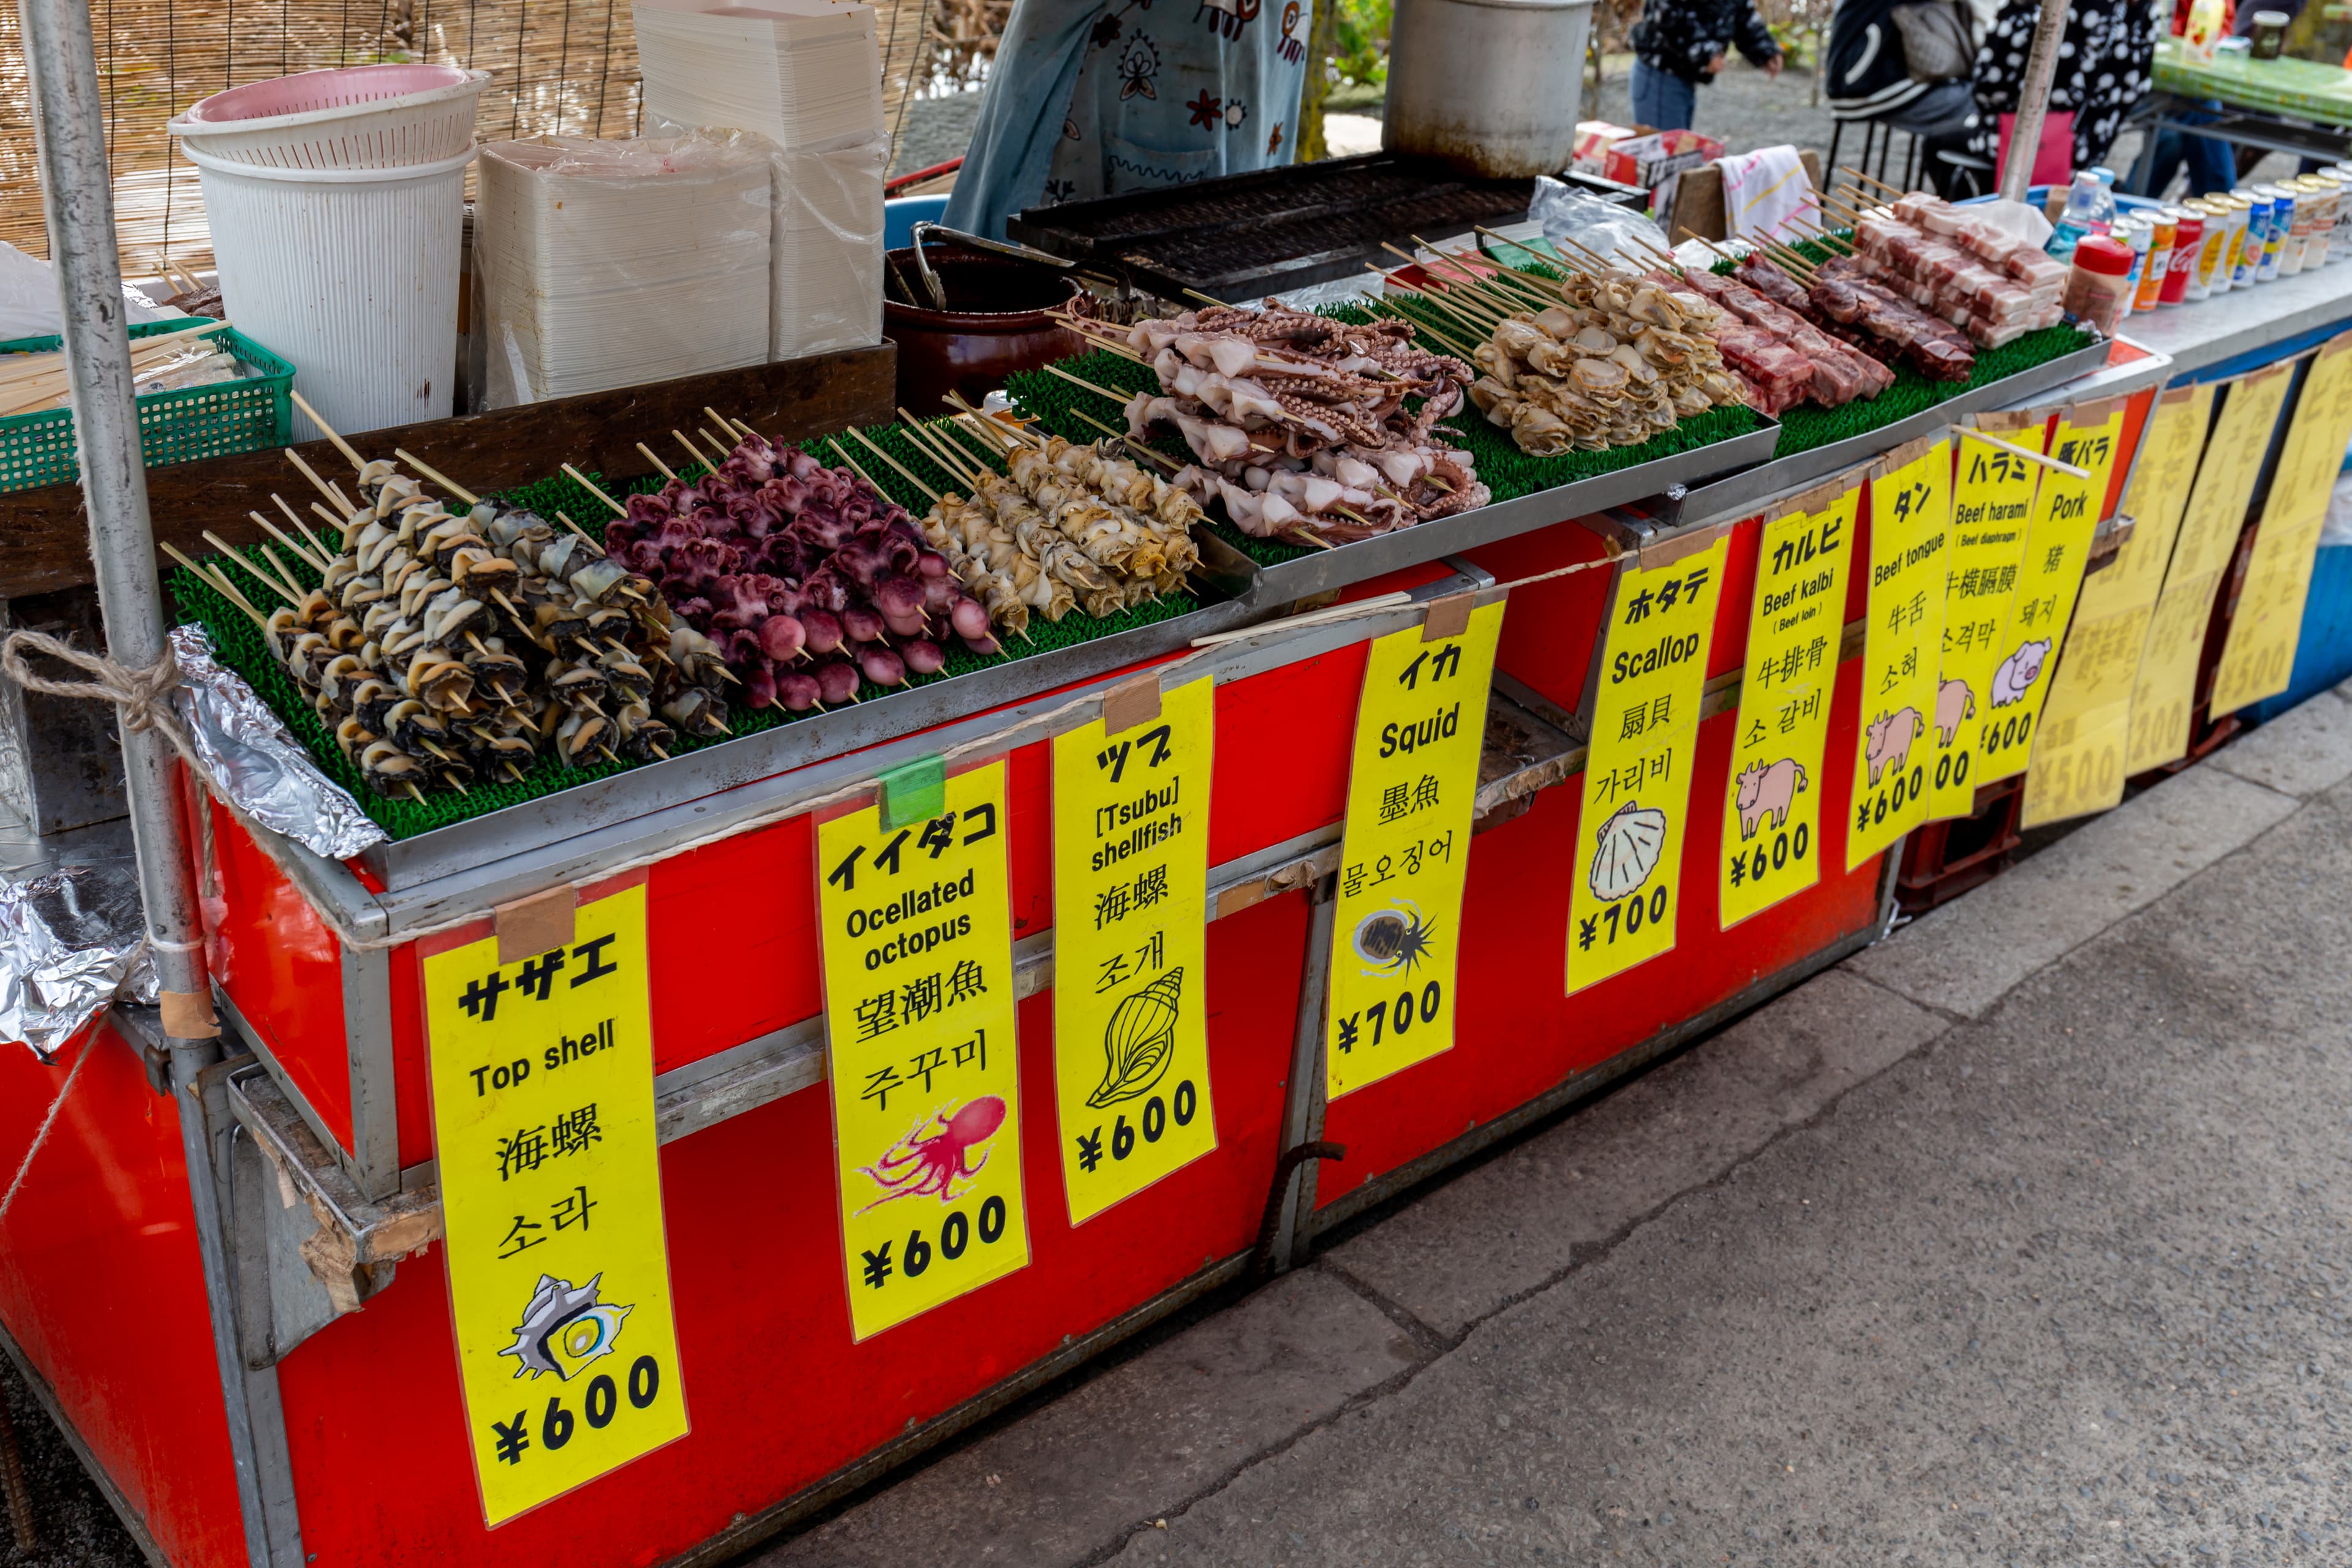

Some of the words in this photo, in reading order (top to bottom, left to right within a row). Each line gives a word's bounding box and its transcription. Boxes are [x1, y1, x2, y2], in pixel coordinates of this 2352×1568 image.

[1968, 452, 2026, 484] ハラミ
[1893, 482, 1931, 522] タン
[1955, 502, 1986, 525] Beef
[1988, 498, 2029, 521] harami
[2049, 491, 2087, 521] Pork
[1773, 516, 1842, 575] カルビ
[1875, 552, 1902, 587] Beef
[1907, 532, 1945, 567] tongue
[1624, 567, 1709, 625] ホタテ
[1763, 584, 1796, 617] Beef
[1801, 568, 1834, 601] kalbi
[1888, 590, 1926, 636] 牛舌
[2019, 594, 2057, 627] 돼지
[1398, 643, 1461, 690] イカ
[1612, 633, 1699, 684] Scallop
[1757, 635, 1828, 689] 牛排骨
[1880, 646, 1917, 695] 소혀
[2219, 641, 2286, 701] ¥500
[1379, 702, 1460, 759] Squid
[1618, 693, 1672, 743] 扇貝
[1378, 774, 1439, 826] 墨魚
[1594, 748, 1672, 804] 가리비
[1857, 766, 1922, 832] ¥600
[2032, 744, 2114, 803] ¥500
[1096, 776, 1179, 838] [Tsubu]
[827, 802, 995, 891] イイダコ
[1091, 813, 1182, 872] shellfish
[1343, 830, 1452, 898] 물오징어
[1731, 822, 1808, 888] ¥600
[846, 869, 974, 938] Ocellated
[1095, 864, 1168, 931] 海螺
[1579, 885, 1667, 952] ¥700
[865, 914, 971, 971] octopus
[1095, 931, 1163, 993] 조개
[458, 933, 617, 1022] サザエ
[854, 960, 988, 1043] 望潮魚
[1338, 981, 1440, 1055] ¥700
[470, 1058, 530, 1097] Top
[545, 1018, 614, 1071] shell
[861, 1028, 986, 1111] 주꾸미
[496, 1103, 603, 1182] 海螺
[1076, 1080, 1196, 1173] ¥600
[497, 1186, 598, 1259] 소라
[861, 1195, 1006, 1289] ¥600
[491, 1355, 659, 1466] ¥600
